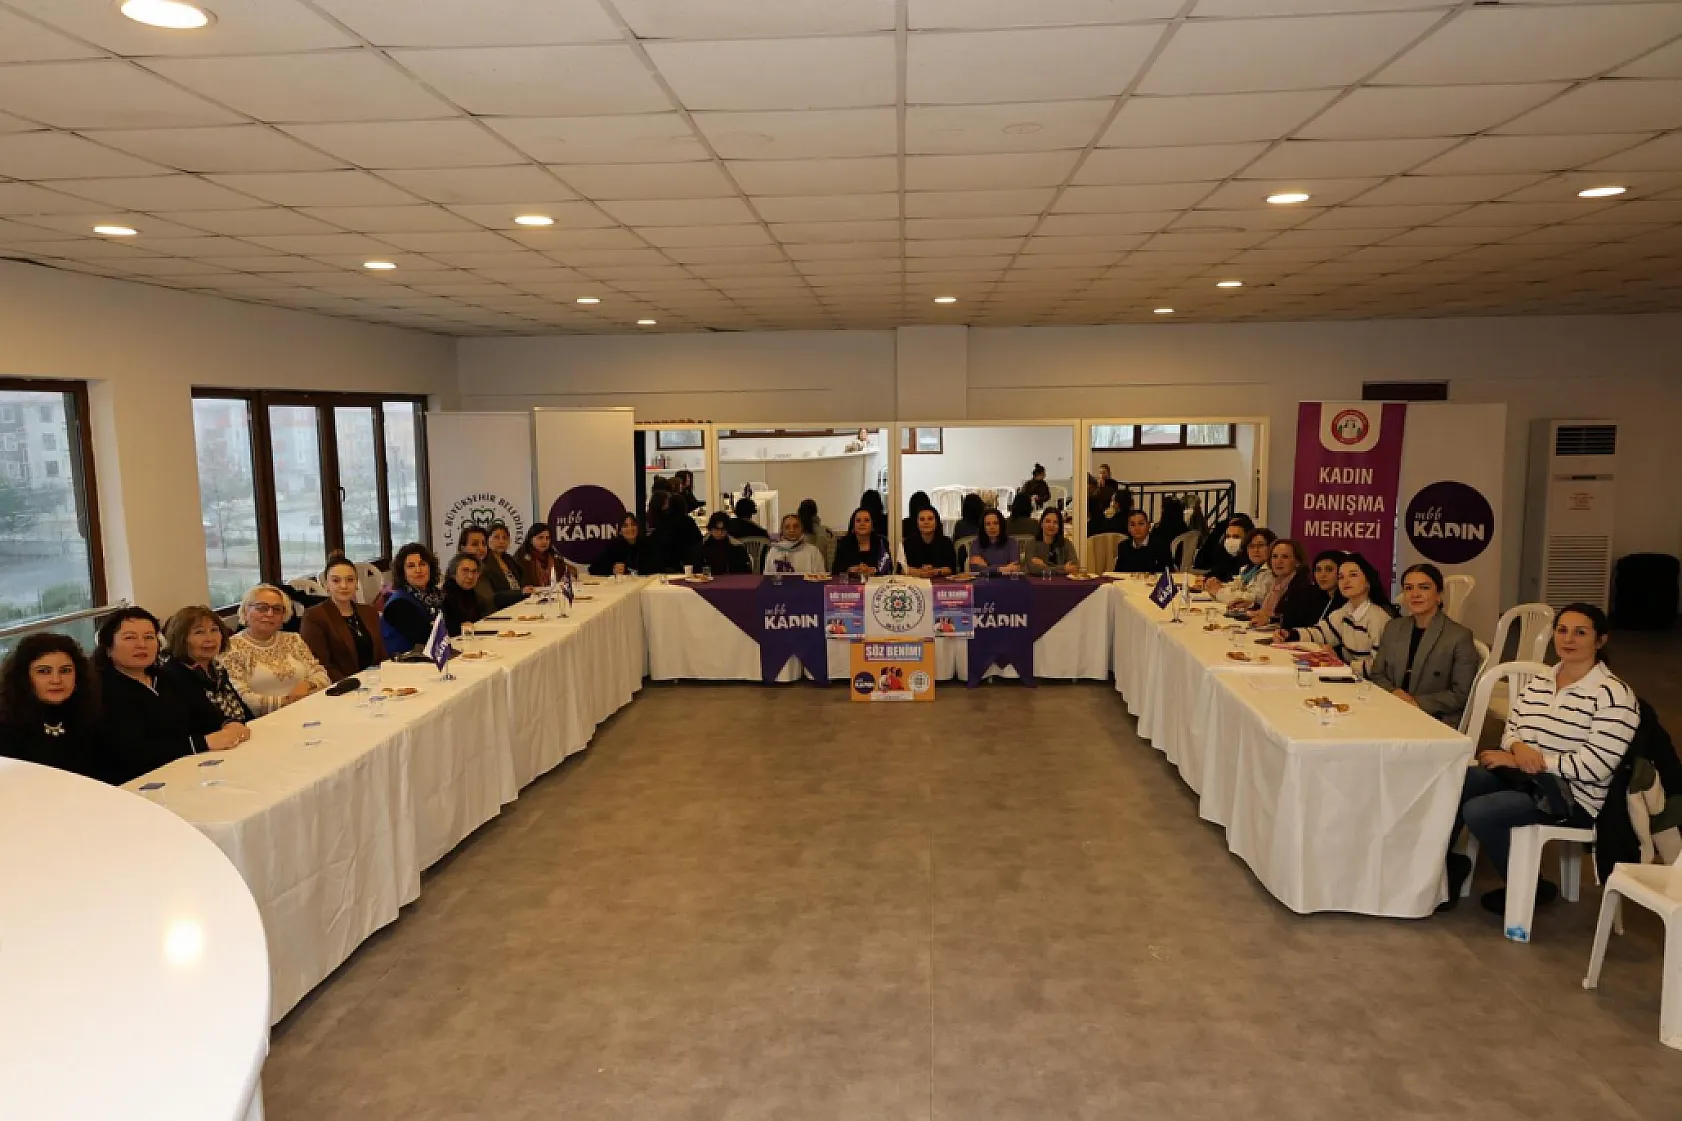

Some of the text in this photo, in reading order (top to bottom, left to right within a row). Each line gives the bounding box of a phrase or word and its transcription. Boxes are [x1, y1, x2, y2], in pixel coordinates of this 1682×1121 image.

[1319, 466, 1374, 485] KADIN
[1303, 493, 1385, 516] DANIŞMA
[1303, 518, 1381, 539] MERKEZİ
[1413, 520, 1485, 540] KADIN
[764, 614, 819, 630] KADIN
[973, 613, 1028, 628] KADIN
[865, 643, 885, 656] SÖZ
